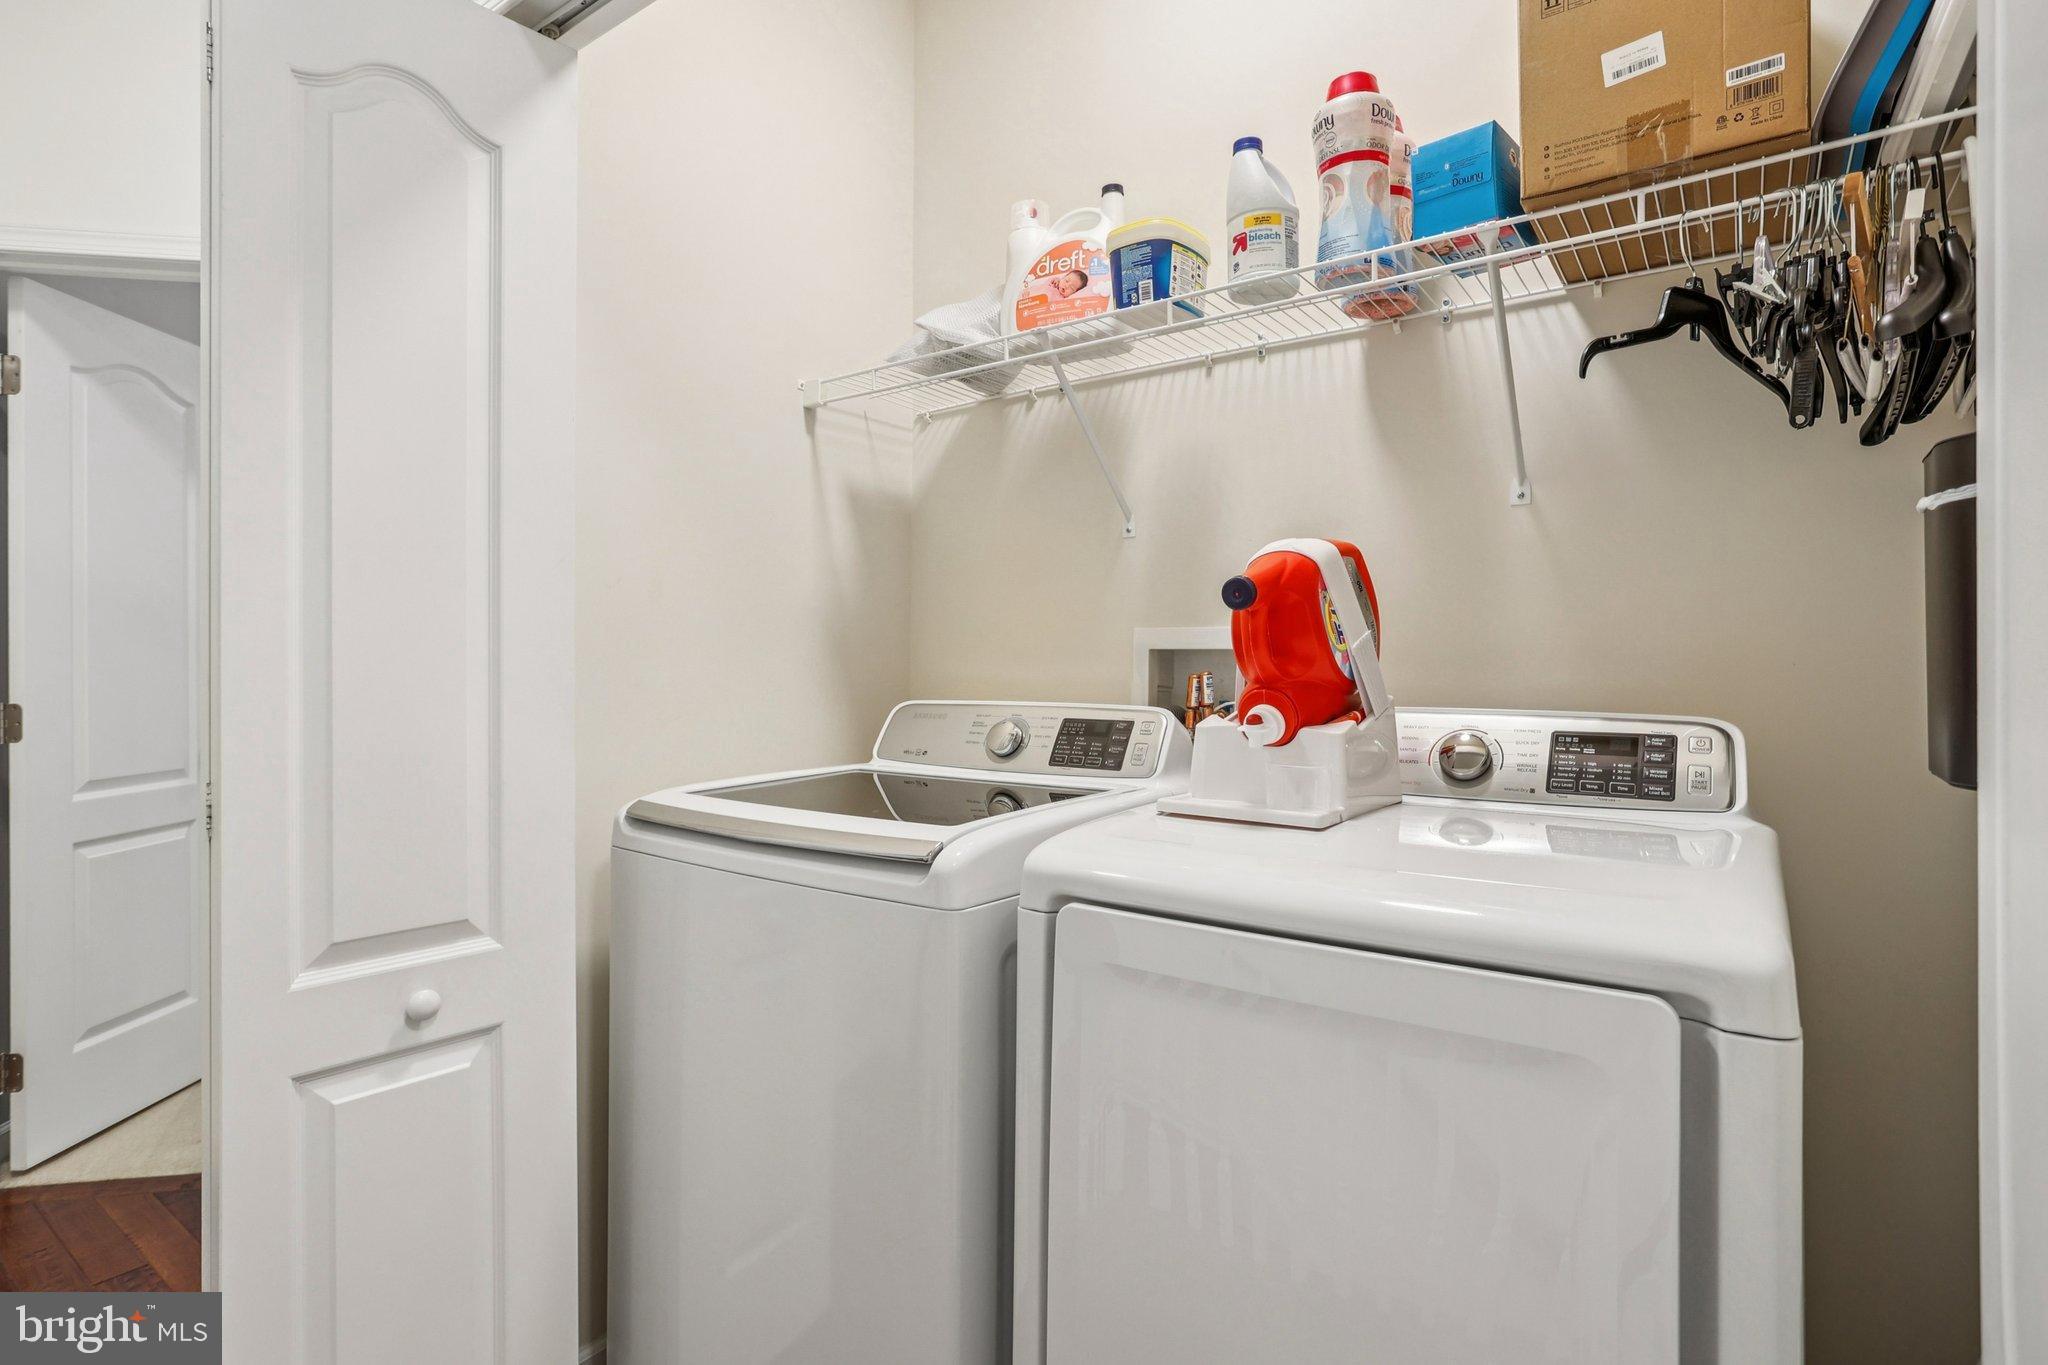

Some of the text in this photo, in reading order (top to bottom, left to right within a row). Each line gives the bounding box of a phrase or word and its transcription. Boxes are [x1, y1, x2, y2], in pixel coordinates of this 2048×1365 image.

[1451, 171, 1485, 188] Downy
[1248, 231, 1281, 242] bleach
[1036, 250, 1086, 276] dreft
